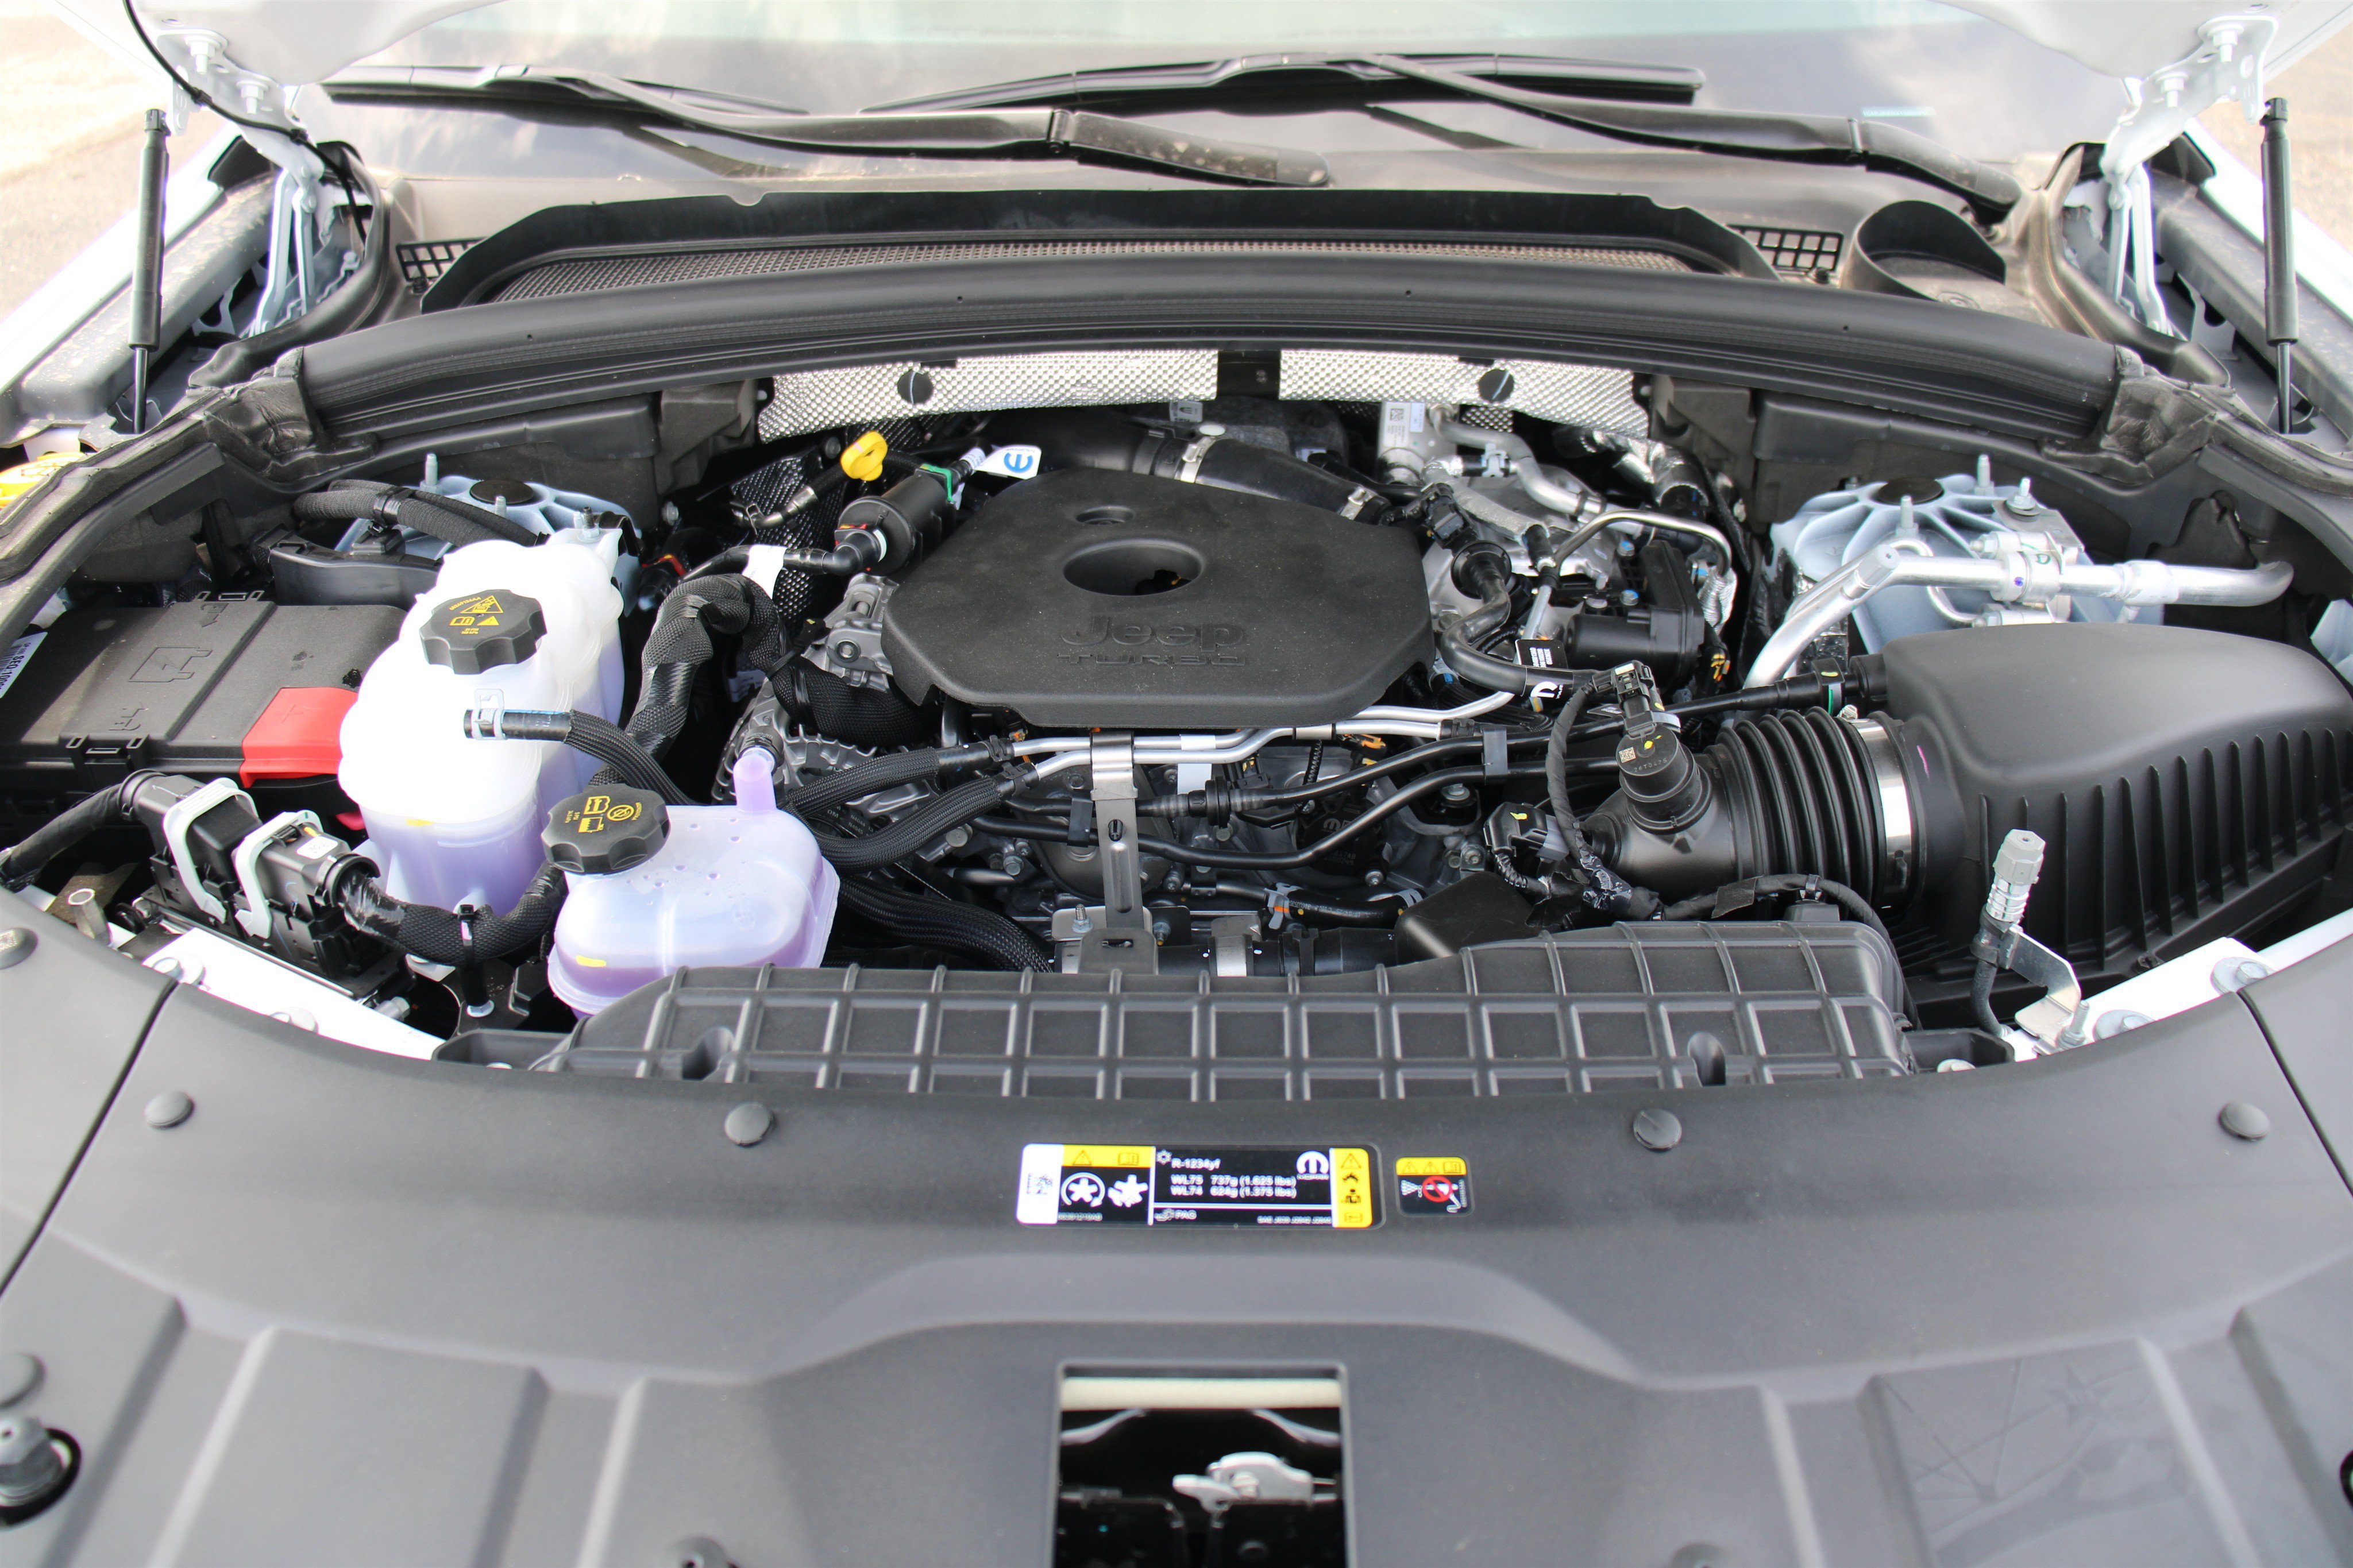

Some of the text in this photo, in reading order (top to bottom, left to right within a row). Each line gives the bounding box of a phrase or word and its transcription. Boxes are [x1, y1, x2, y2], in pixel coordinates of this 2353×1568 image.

[1061, 616, 1246, 652] Jeep
[1058, 654, 1246, 666] TURBO
[1171, 1158, 1221, 1171] R-1234yf
[1210, 1175, 1239, 1187] 737g
[1274, 1175, 1297, 1188] lbs)
[1274, 1186, 1297, 1199] lbs)
